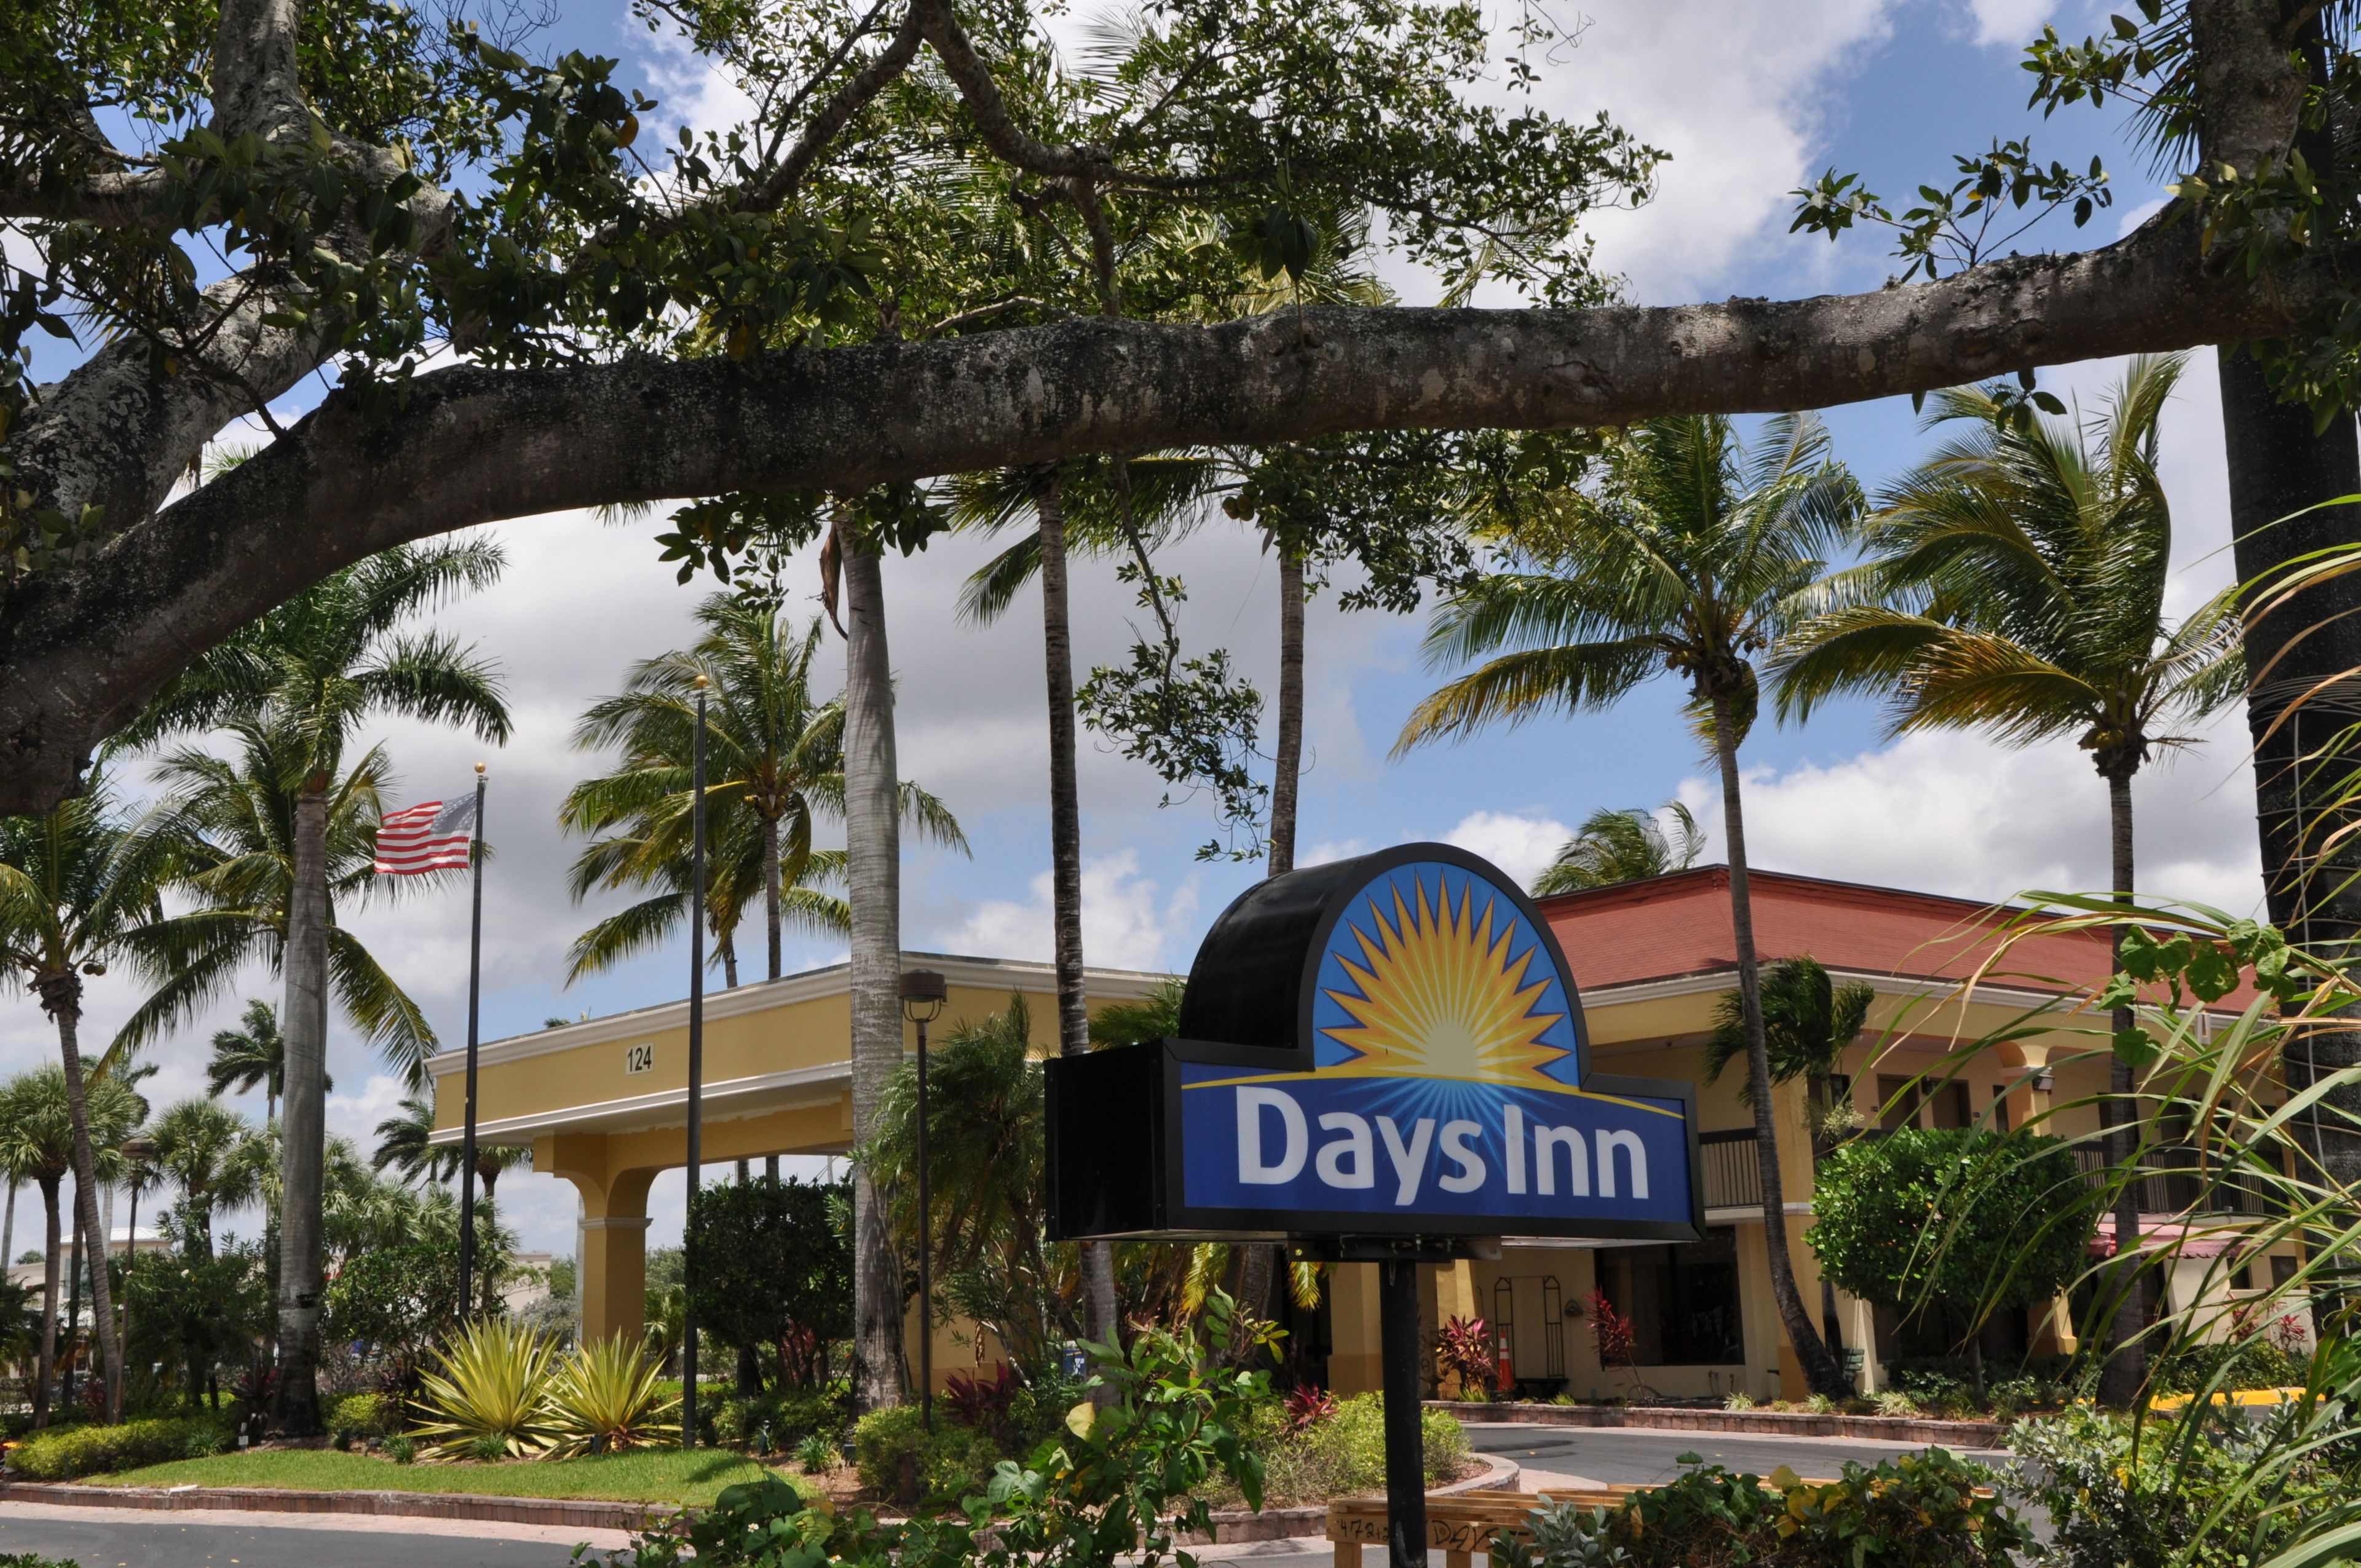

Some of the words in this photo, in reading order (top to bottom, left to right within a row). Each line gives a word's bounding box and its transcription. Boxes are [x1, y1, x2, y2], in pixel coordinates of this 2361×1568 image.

[627, 1045, 652, 1072] 124
[1236, 1085, 1487, 1206] Days
[1503, 1104, 1649, 1200] Inn
